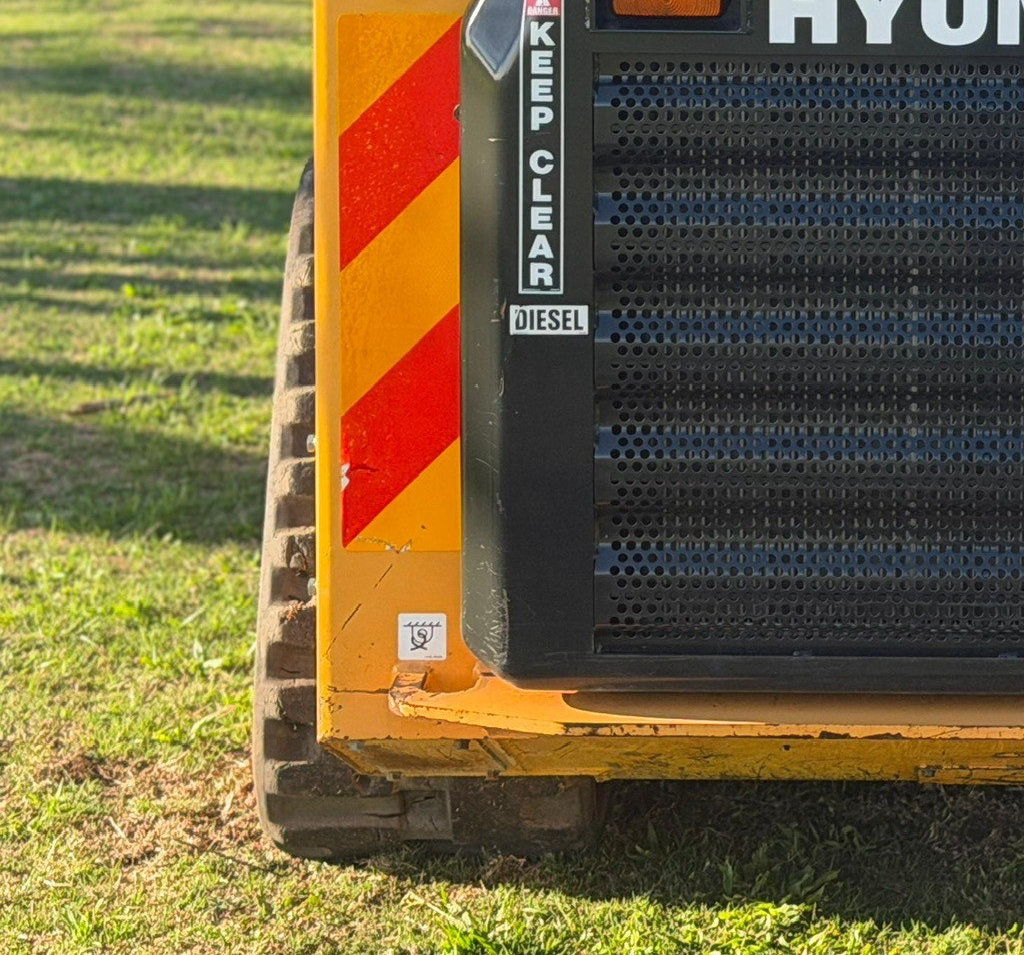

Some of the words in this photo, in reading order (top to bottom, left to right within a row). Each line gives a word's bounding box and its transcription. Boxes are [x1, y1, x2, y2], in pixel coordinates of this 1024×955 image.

[530, 21, 556, 131] KEEP
[528, 149, 555, 287] CLEAR
[515, 309, 584, 331] DIESEL
